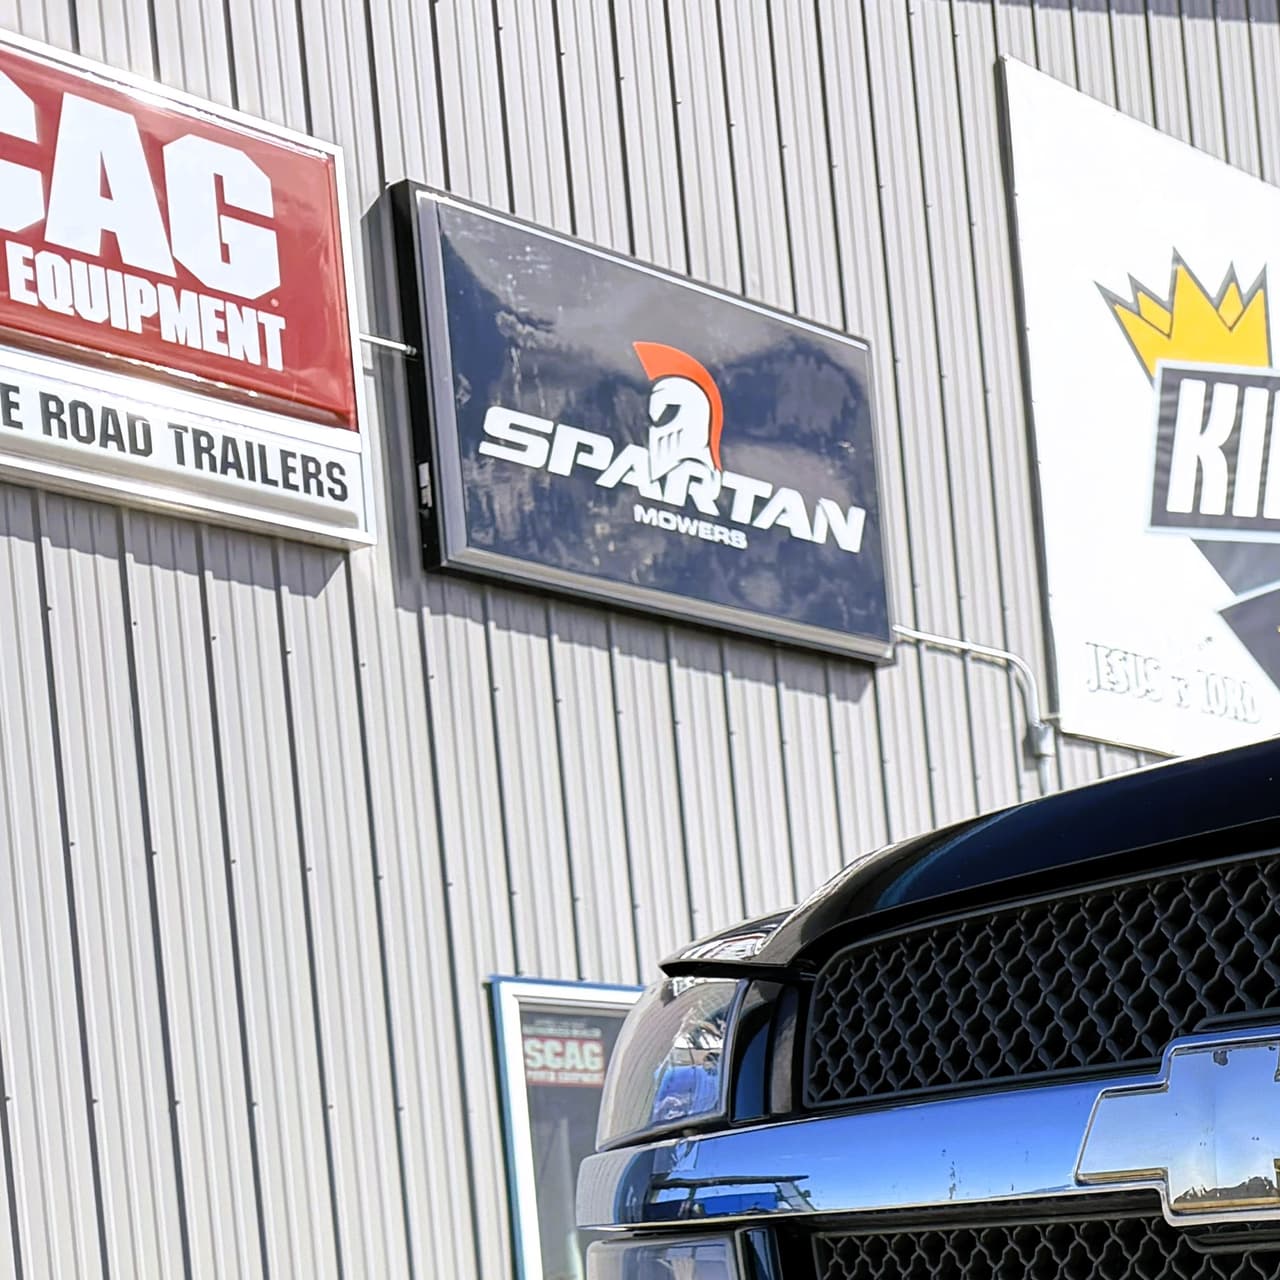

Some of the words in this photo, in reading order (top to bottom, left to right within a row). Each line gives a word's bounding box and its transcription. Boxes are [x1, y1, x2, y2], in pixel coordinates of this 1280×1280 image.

[5, 240, 286, 372] EQUIPMENT
[39, 391, 154, 458] ROAD
[167, 423, 349, 502] TRAILERS
[478, 405, 867, 555] SPARTAN
[633, 504, 749, 550] MOWERS
[524, 1038, 604, 1071] SCAG
